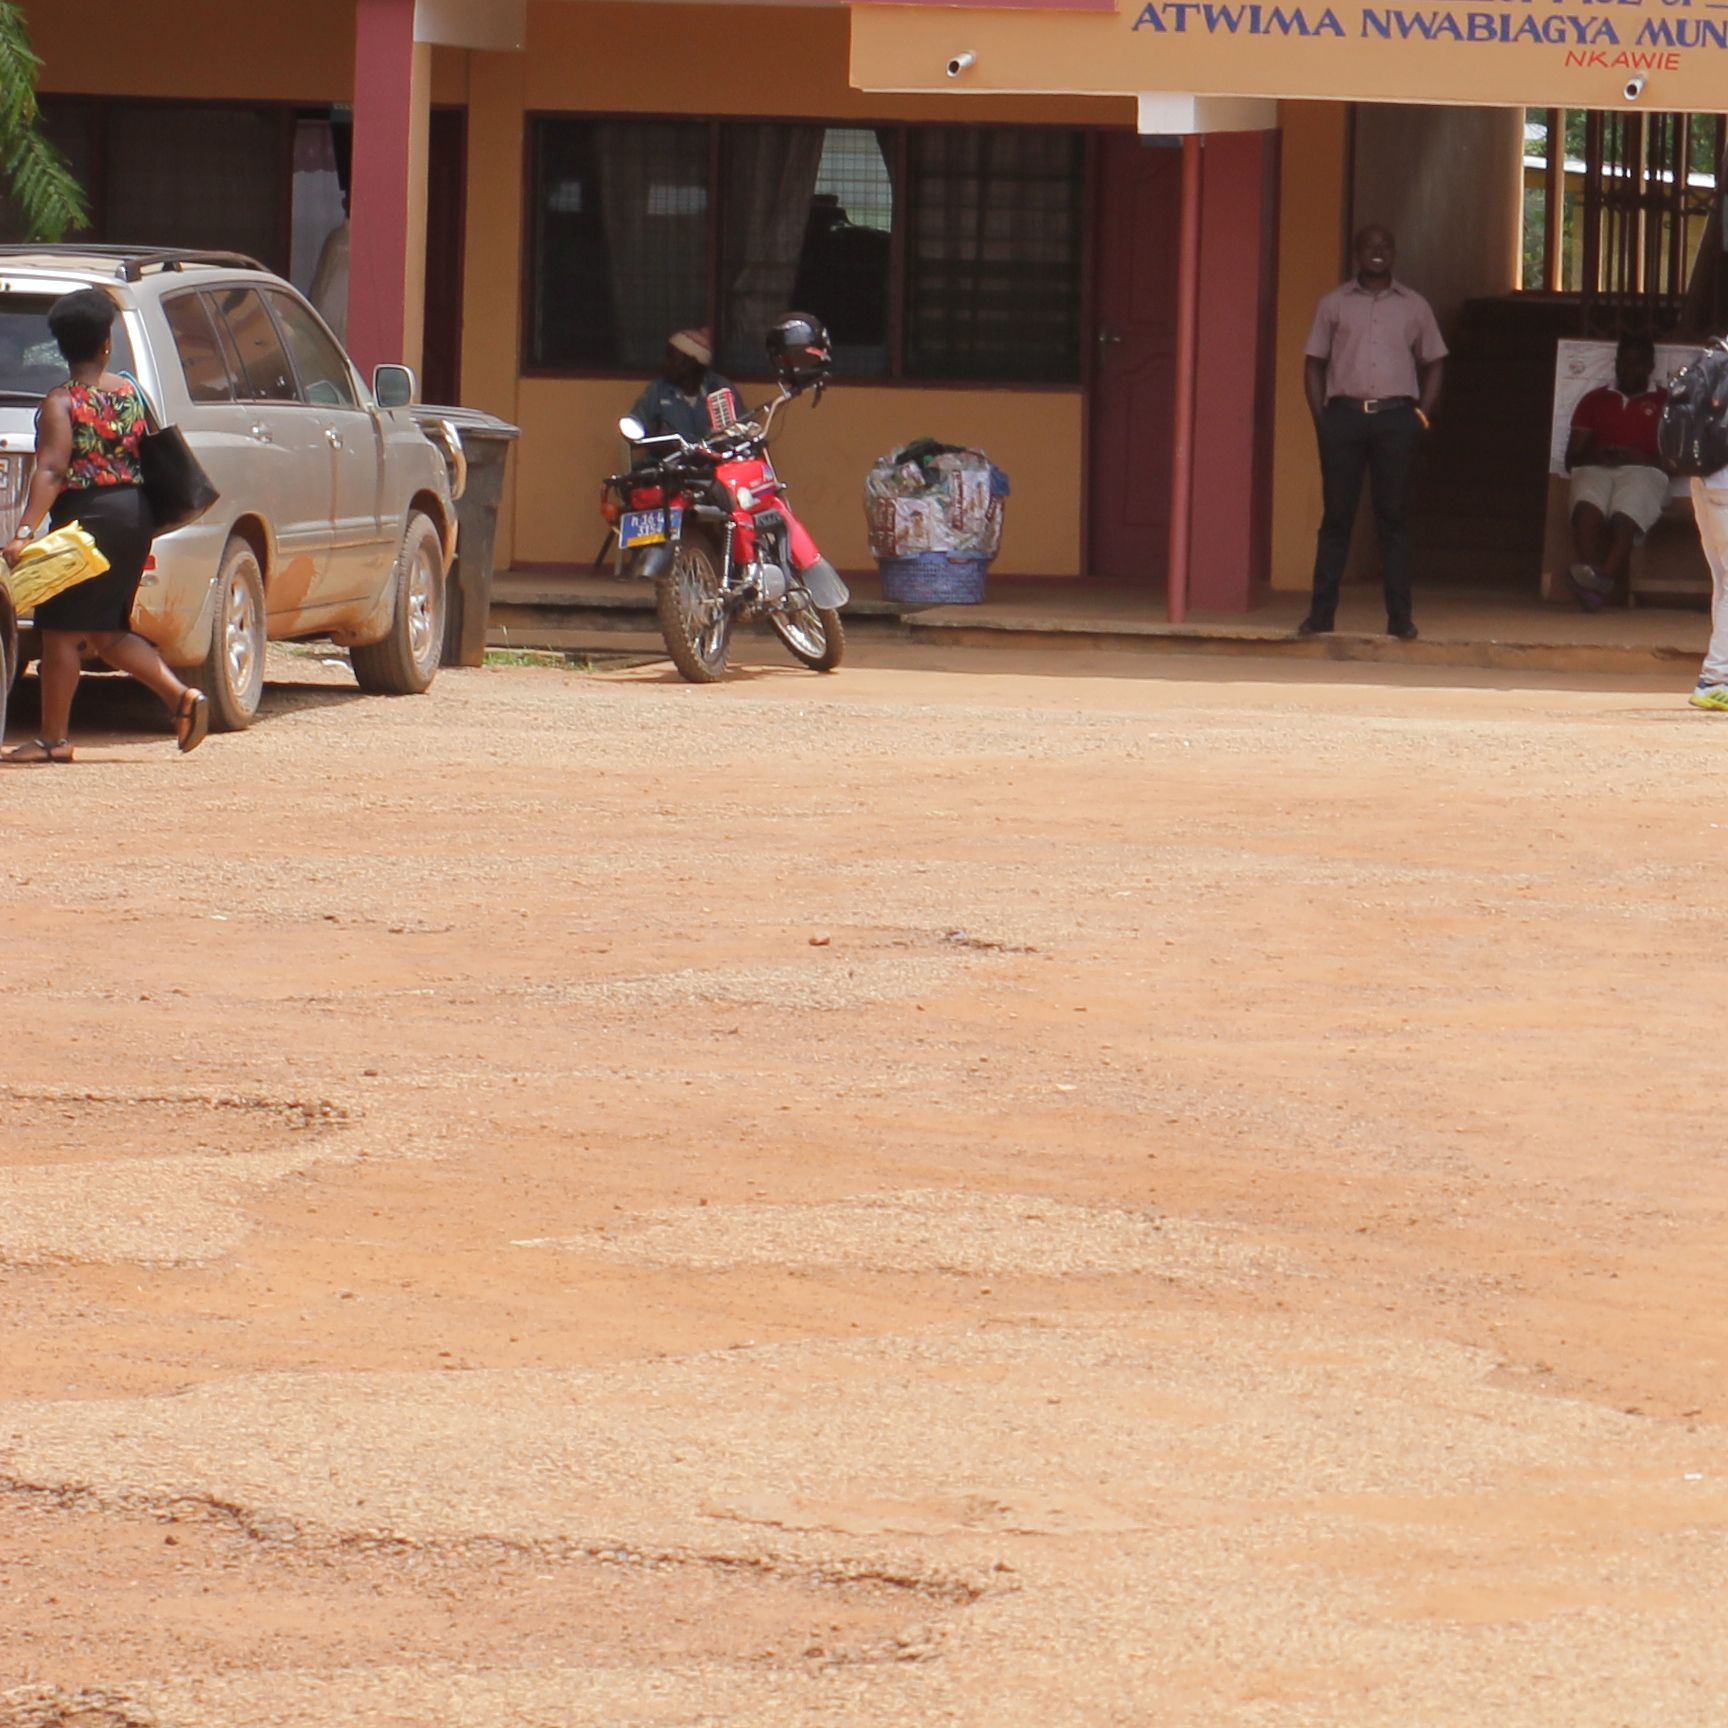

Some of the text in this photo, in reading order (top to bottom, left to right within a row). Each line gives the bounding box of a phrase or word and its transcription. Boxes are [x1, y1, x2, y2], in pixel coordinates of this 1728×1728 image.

[1132, 3, 1345, 37] ATWIMA
[1361, 9, 1619, 45] NWABIAGYA
[1564, 49, 1681, 71] NKAWIE
